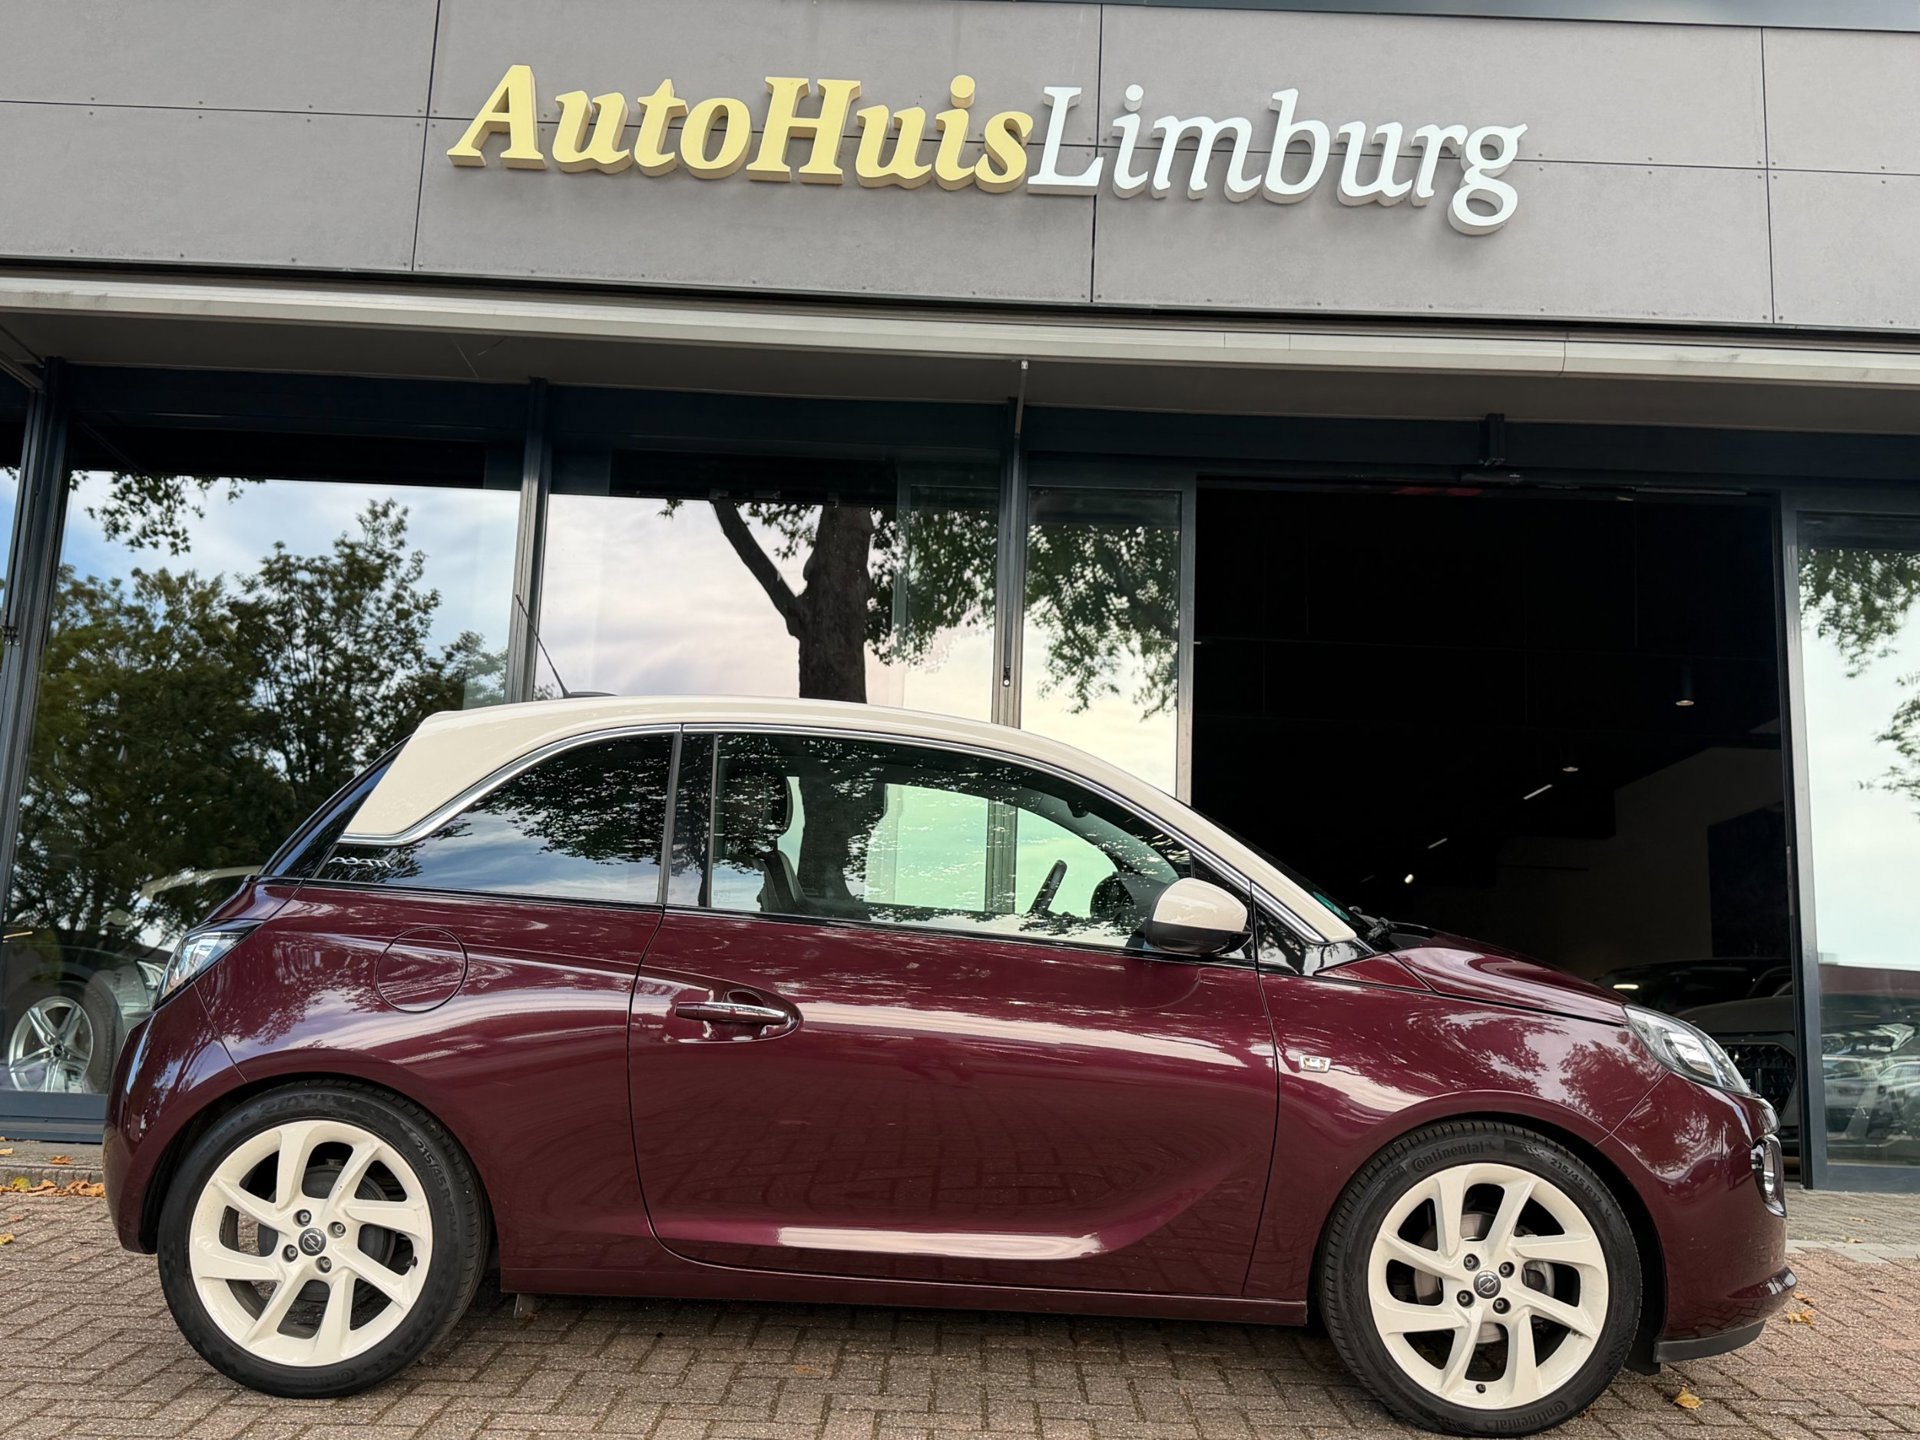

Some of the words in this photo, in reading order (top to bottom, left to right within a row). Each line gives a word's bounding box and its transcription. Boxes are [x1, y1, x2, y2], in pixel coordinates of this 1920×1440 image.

[447, 64, 1528, 235] AutoHuisLimburg
[1412, 1141, 1484, 1170] Continental
[1549, 1157, 1586, 1186] 215/45
